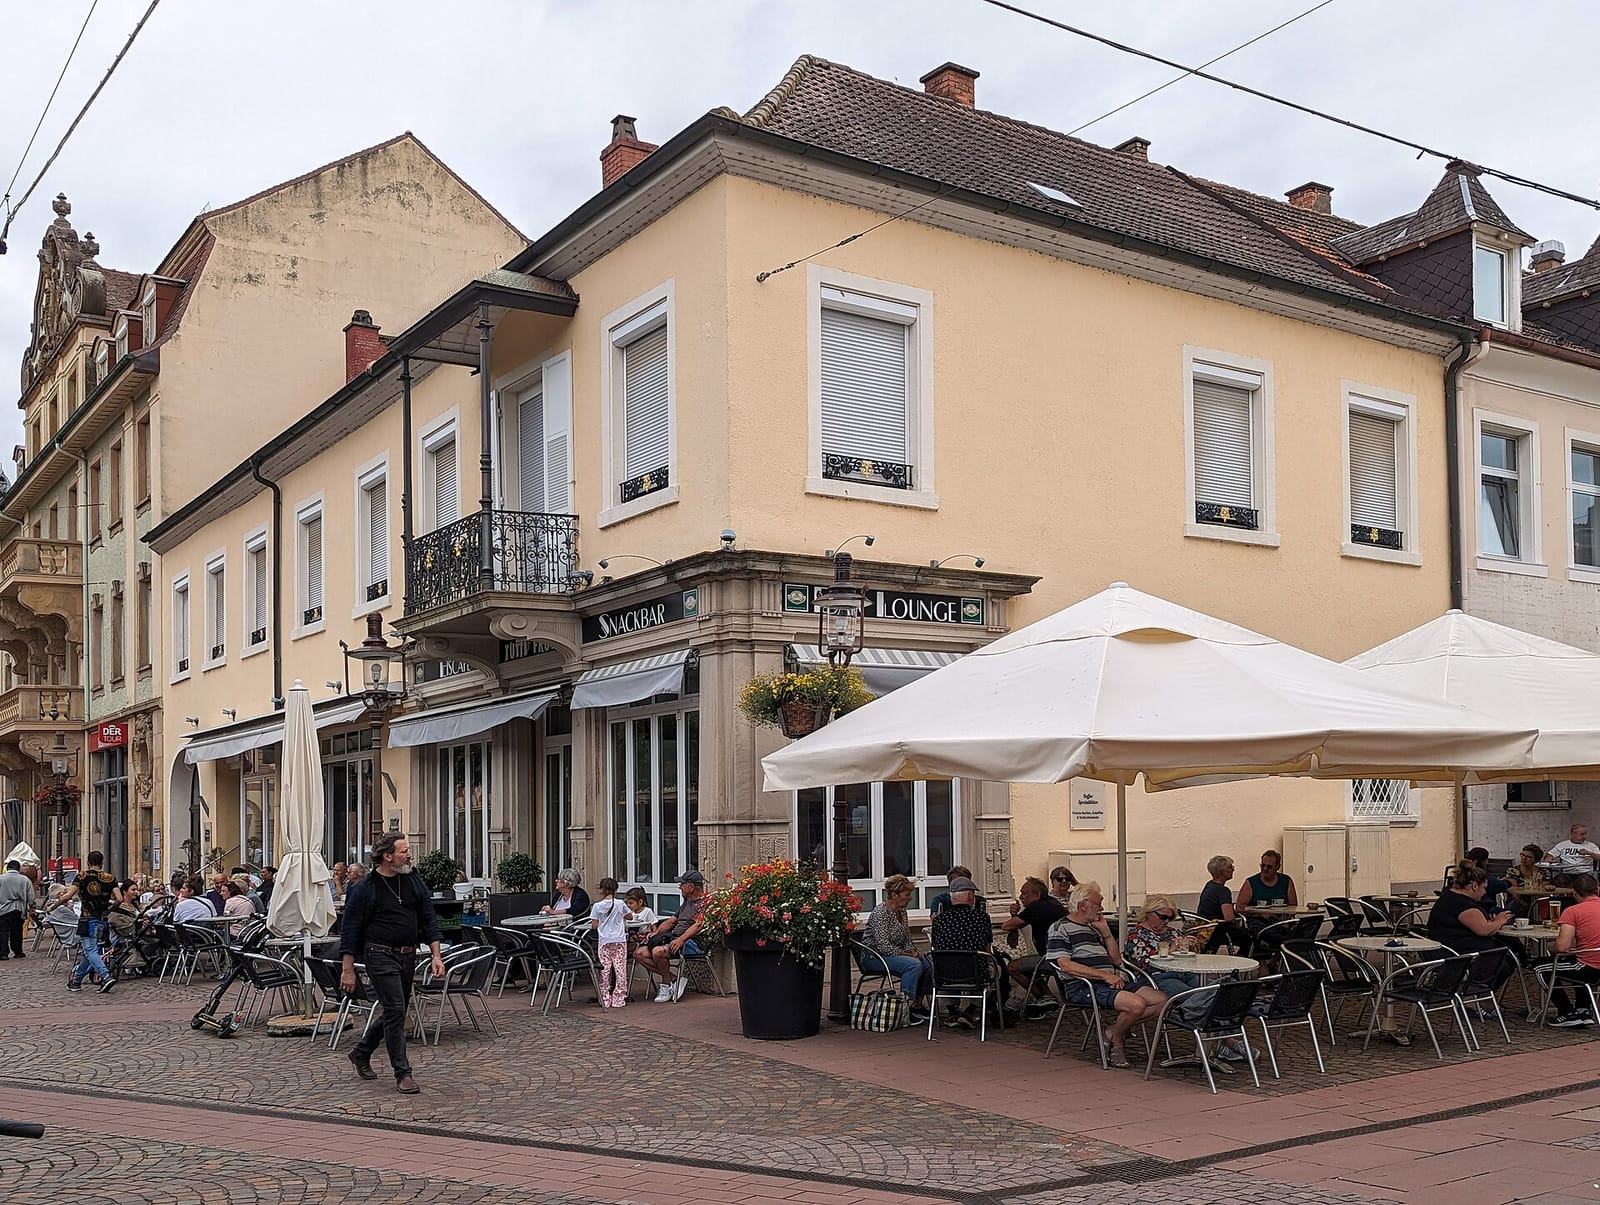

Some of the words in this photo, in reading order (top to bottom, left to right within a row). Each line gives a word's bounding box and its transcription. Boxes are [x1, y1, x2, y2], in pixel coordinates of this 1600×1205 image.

[877, 591, 957, 623] LOUNGE
[598, 603, 665, 639] SNACKBAR
[102, 726, 122, 736] DER
[103, 735, 122, 743] TOUR
